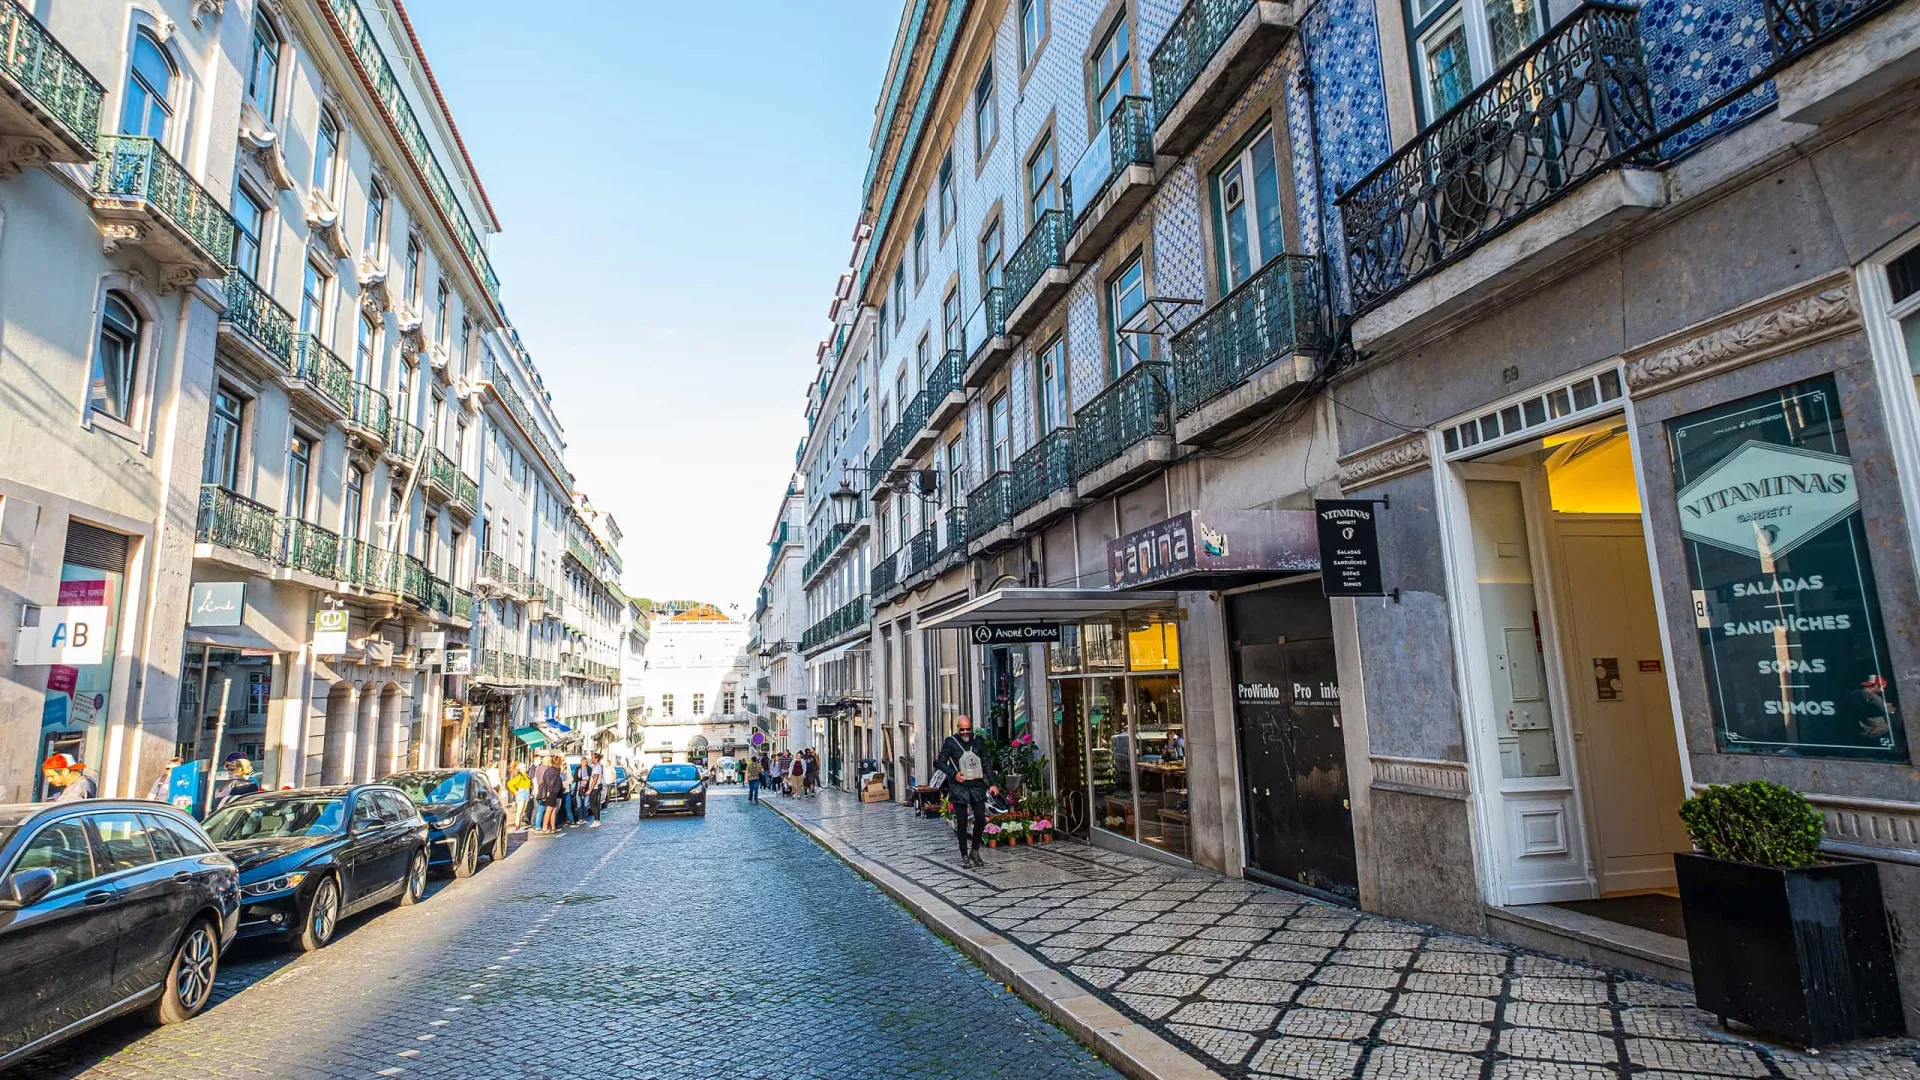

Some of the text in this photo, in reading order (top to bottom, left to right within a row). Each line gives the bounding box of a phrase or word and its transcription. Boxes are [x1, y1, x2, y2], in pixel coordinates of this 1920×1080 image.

[1683, 473, 1847, 519] VITAMINAS
[1321, 509, 1370, 520] VITAMINAS
[1736, 505, 1793, 523] GARRETT
[1733, 575, 1824, 597] SALADAS
[995, 627, 1023, 638] ANDRÉ
[1024, 627, 1057, 637] OPTICAS
[1724, 614, 1851, 636] SANDUÍCHES
[1758, 658, 1827, 674] SOPAS
[1238, 683, 1279, 698] ProWinko
[1293, 683, 1312, 699] Pro
[1764, 700, 1836, 716] SUMOS
